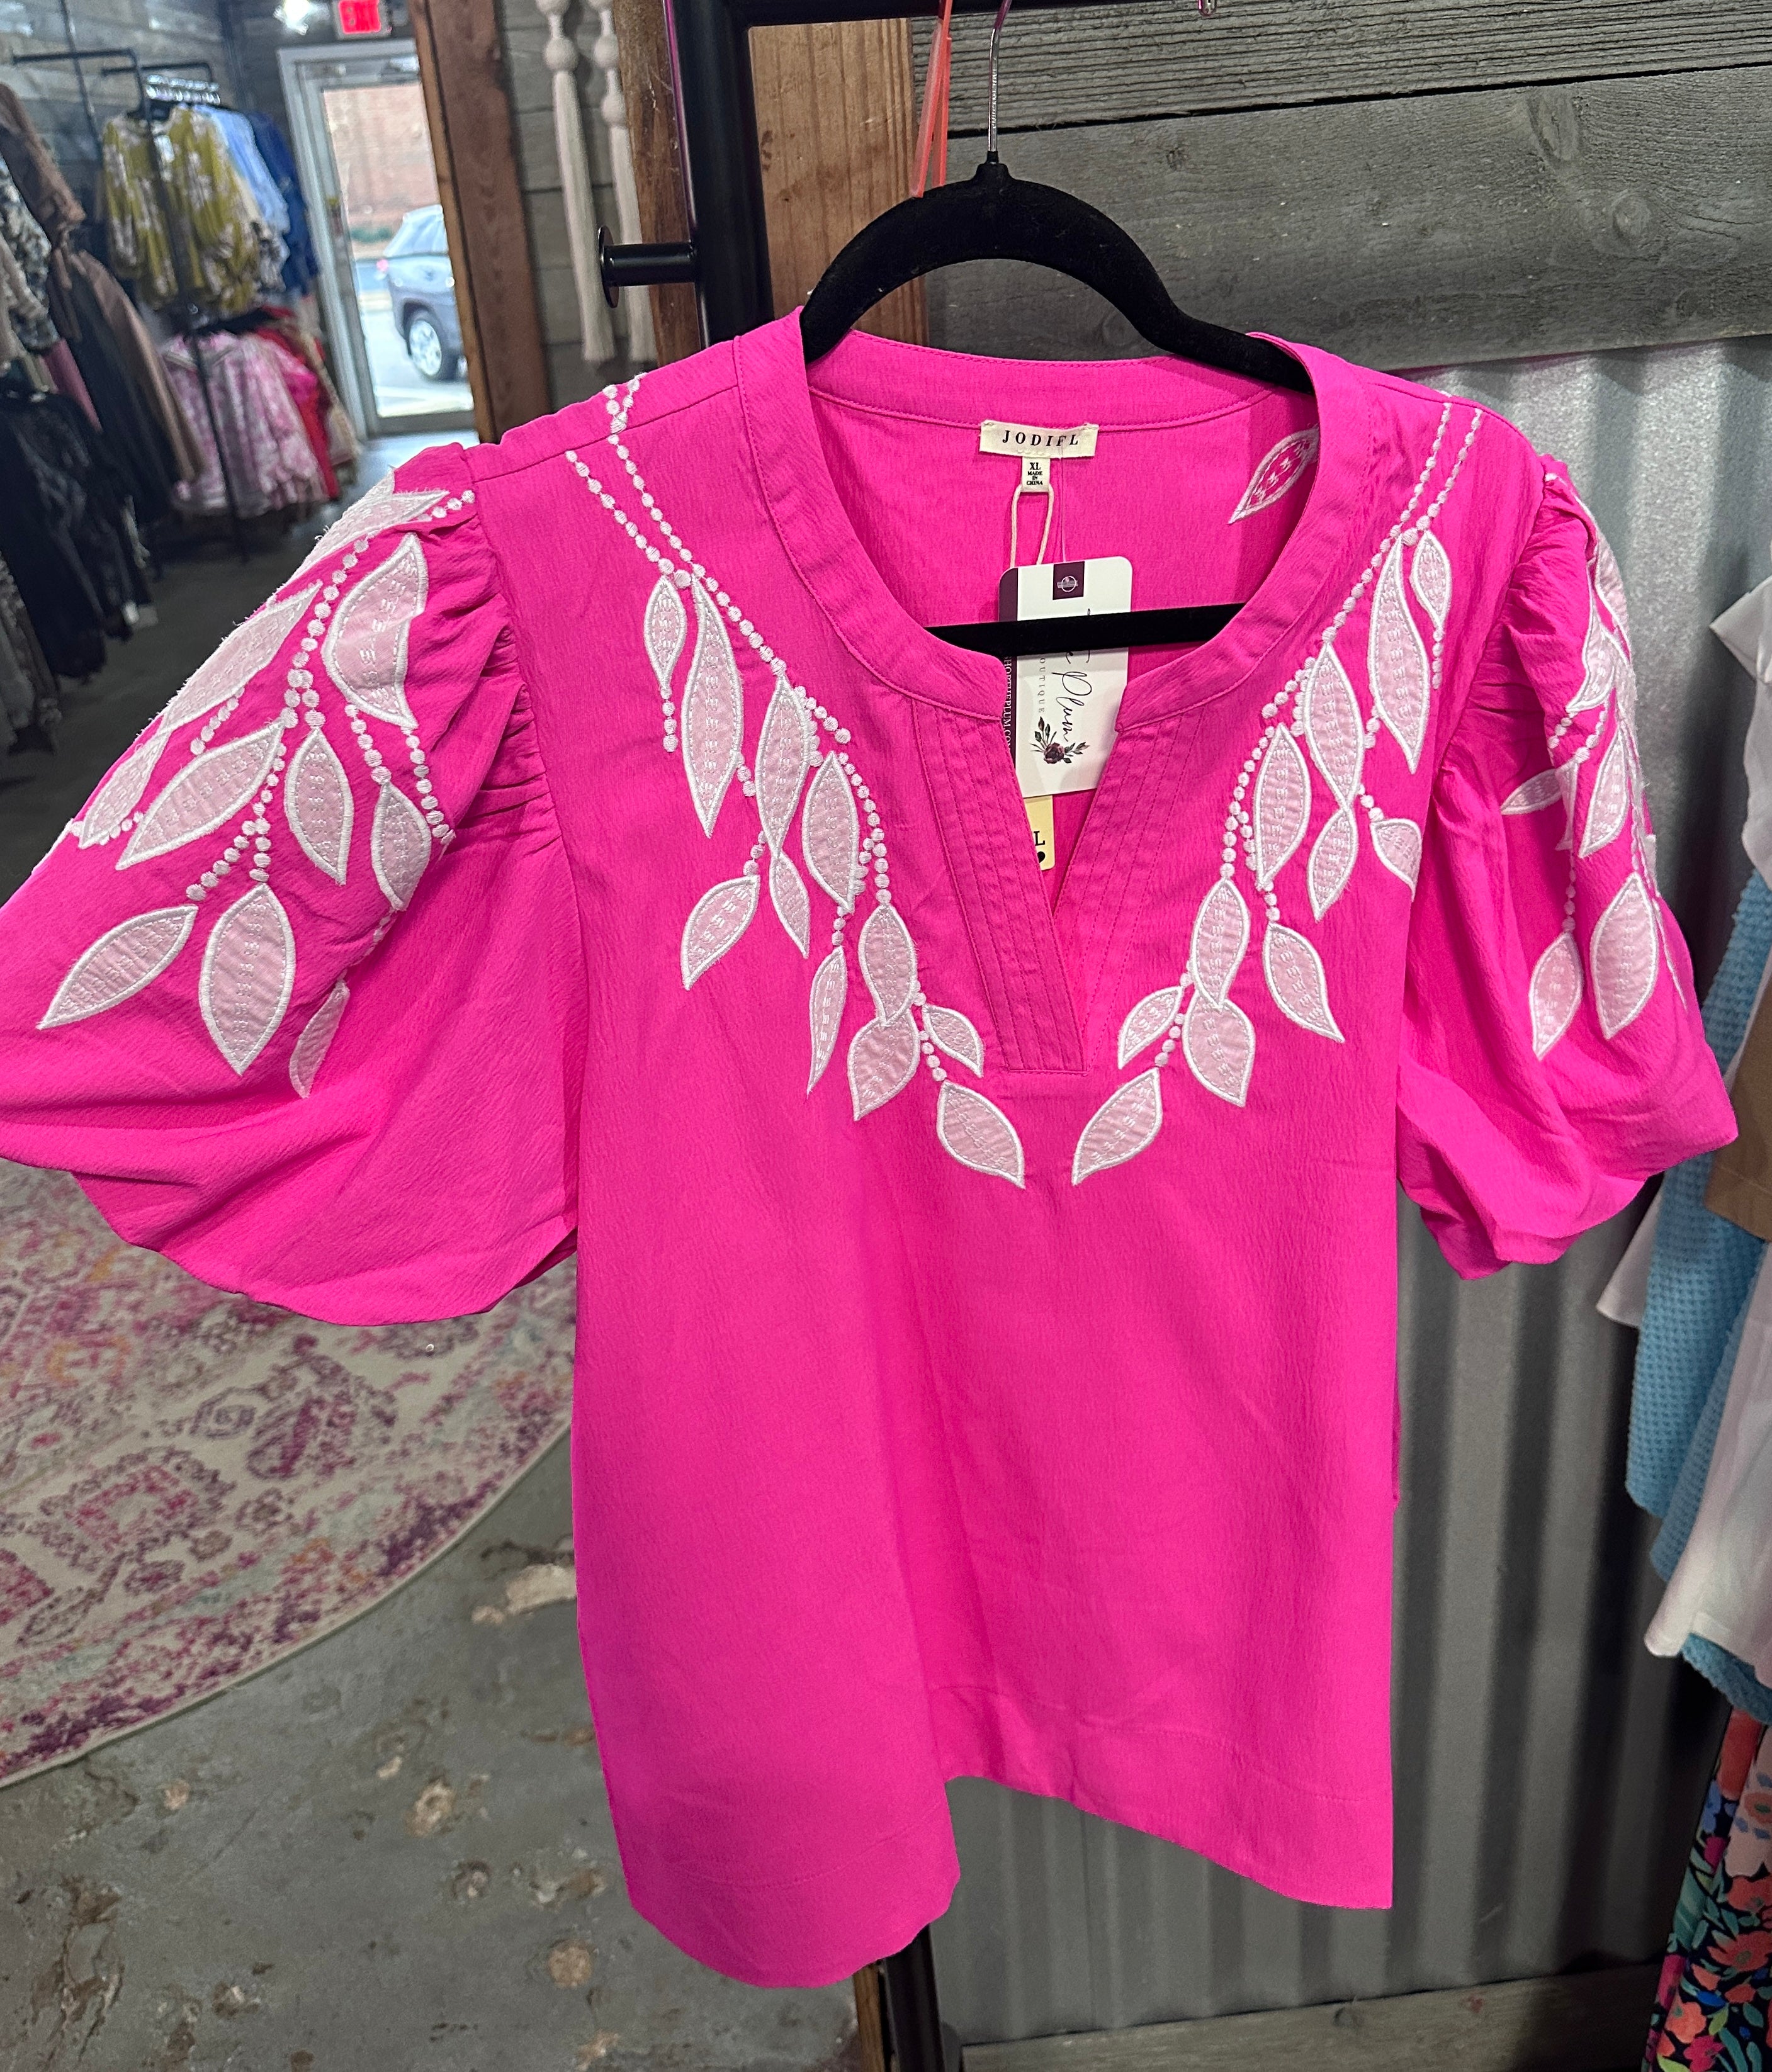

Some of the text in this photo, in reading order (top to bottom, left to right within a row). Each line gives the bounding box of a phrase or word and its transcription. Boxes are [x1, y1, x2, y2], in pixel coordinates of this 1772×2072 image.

[1029, 462, 1041, 470] XL
[1037, 657, 1046, 713] OUTIQUE
[1051, 671, 1093, 743] Plum
